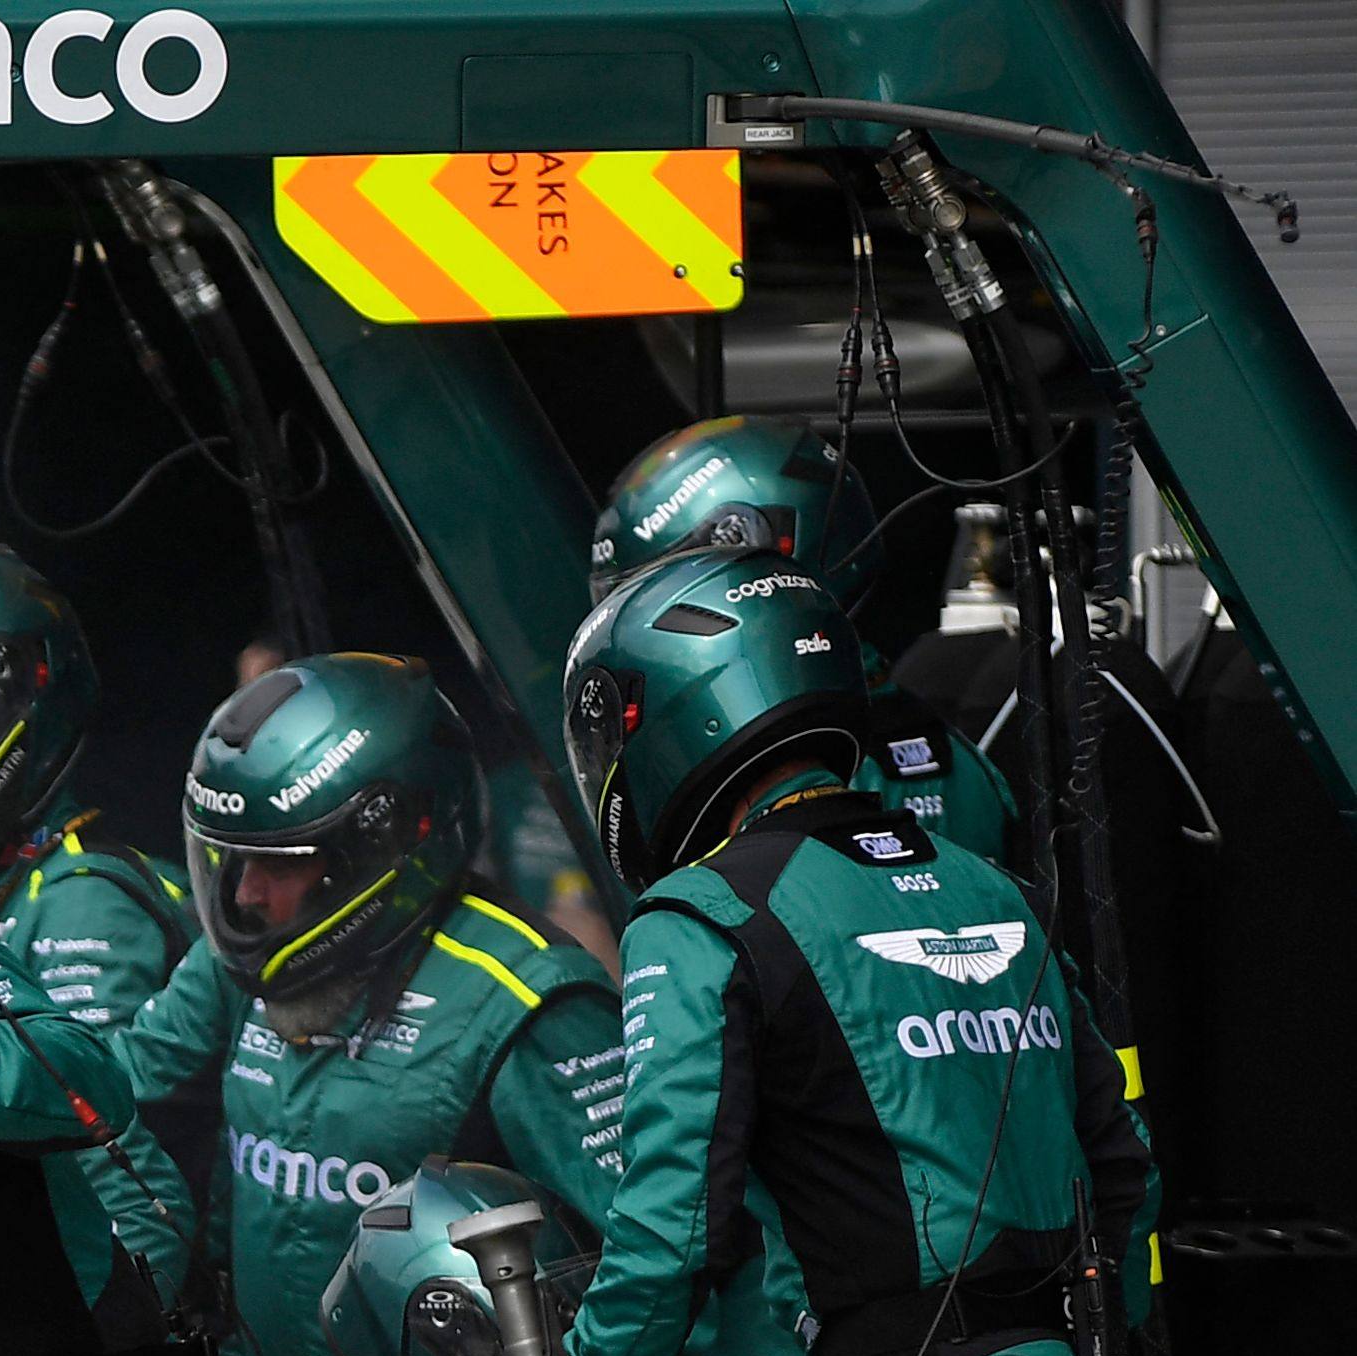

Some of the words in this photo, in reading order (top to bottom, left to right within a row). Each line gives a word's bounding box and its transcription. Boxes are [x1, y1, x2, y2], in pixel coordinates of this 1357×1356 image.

[746, 129, 769, 139] REAR
[770, 128, 792, 138] JACK
[892, 872, 940, 893] BOSS
[896, 1004, 1062, 1059] aramco
